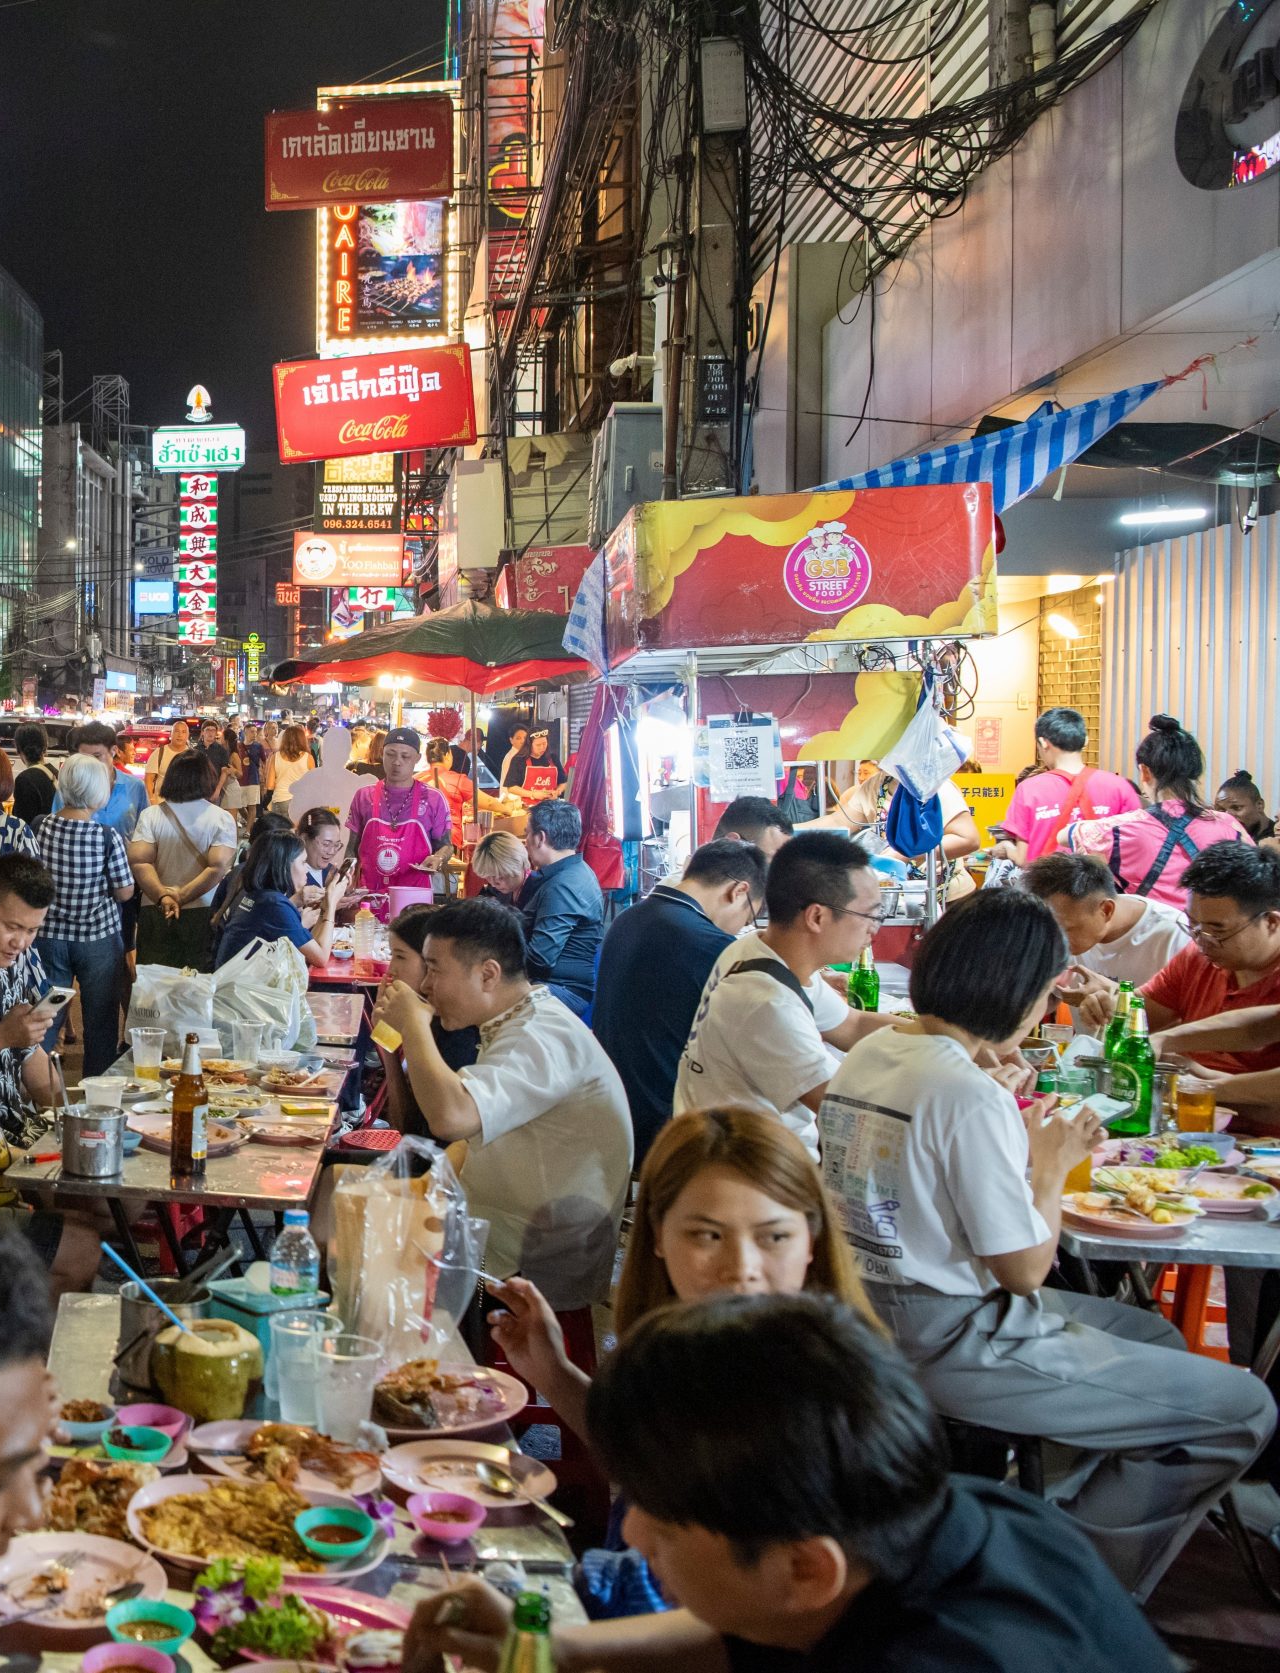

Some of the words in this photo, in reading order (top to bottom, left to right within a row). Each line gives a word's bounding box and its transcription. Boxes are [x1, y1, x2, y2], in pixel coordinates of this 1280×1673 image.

[323, 485, 367, 494] TRESPASSERS
[368, 485, 384, 494] WILL
[385, 485, 395, 494] BE
[319, 493, 338, 503] USED
[339, 493, 349, 503] AS
[349, 493, 398, 503] INGREDIENTS
[322, 503, 335, 516] IN
[337, 503, 361, 516] THE
[362, 503, 394, 516] BREW
[323, 519, 393, 529] 096.324.6541
[188, 478, 209, 642] 和成興大金行
[805, 558, 850, 579] GSB
[808, 580, 849, 592] STREET
[360, 587, 383, 605] 行
